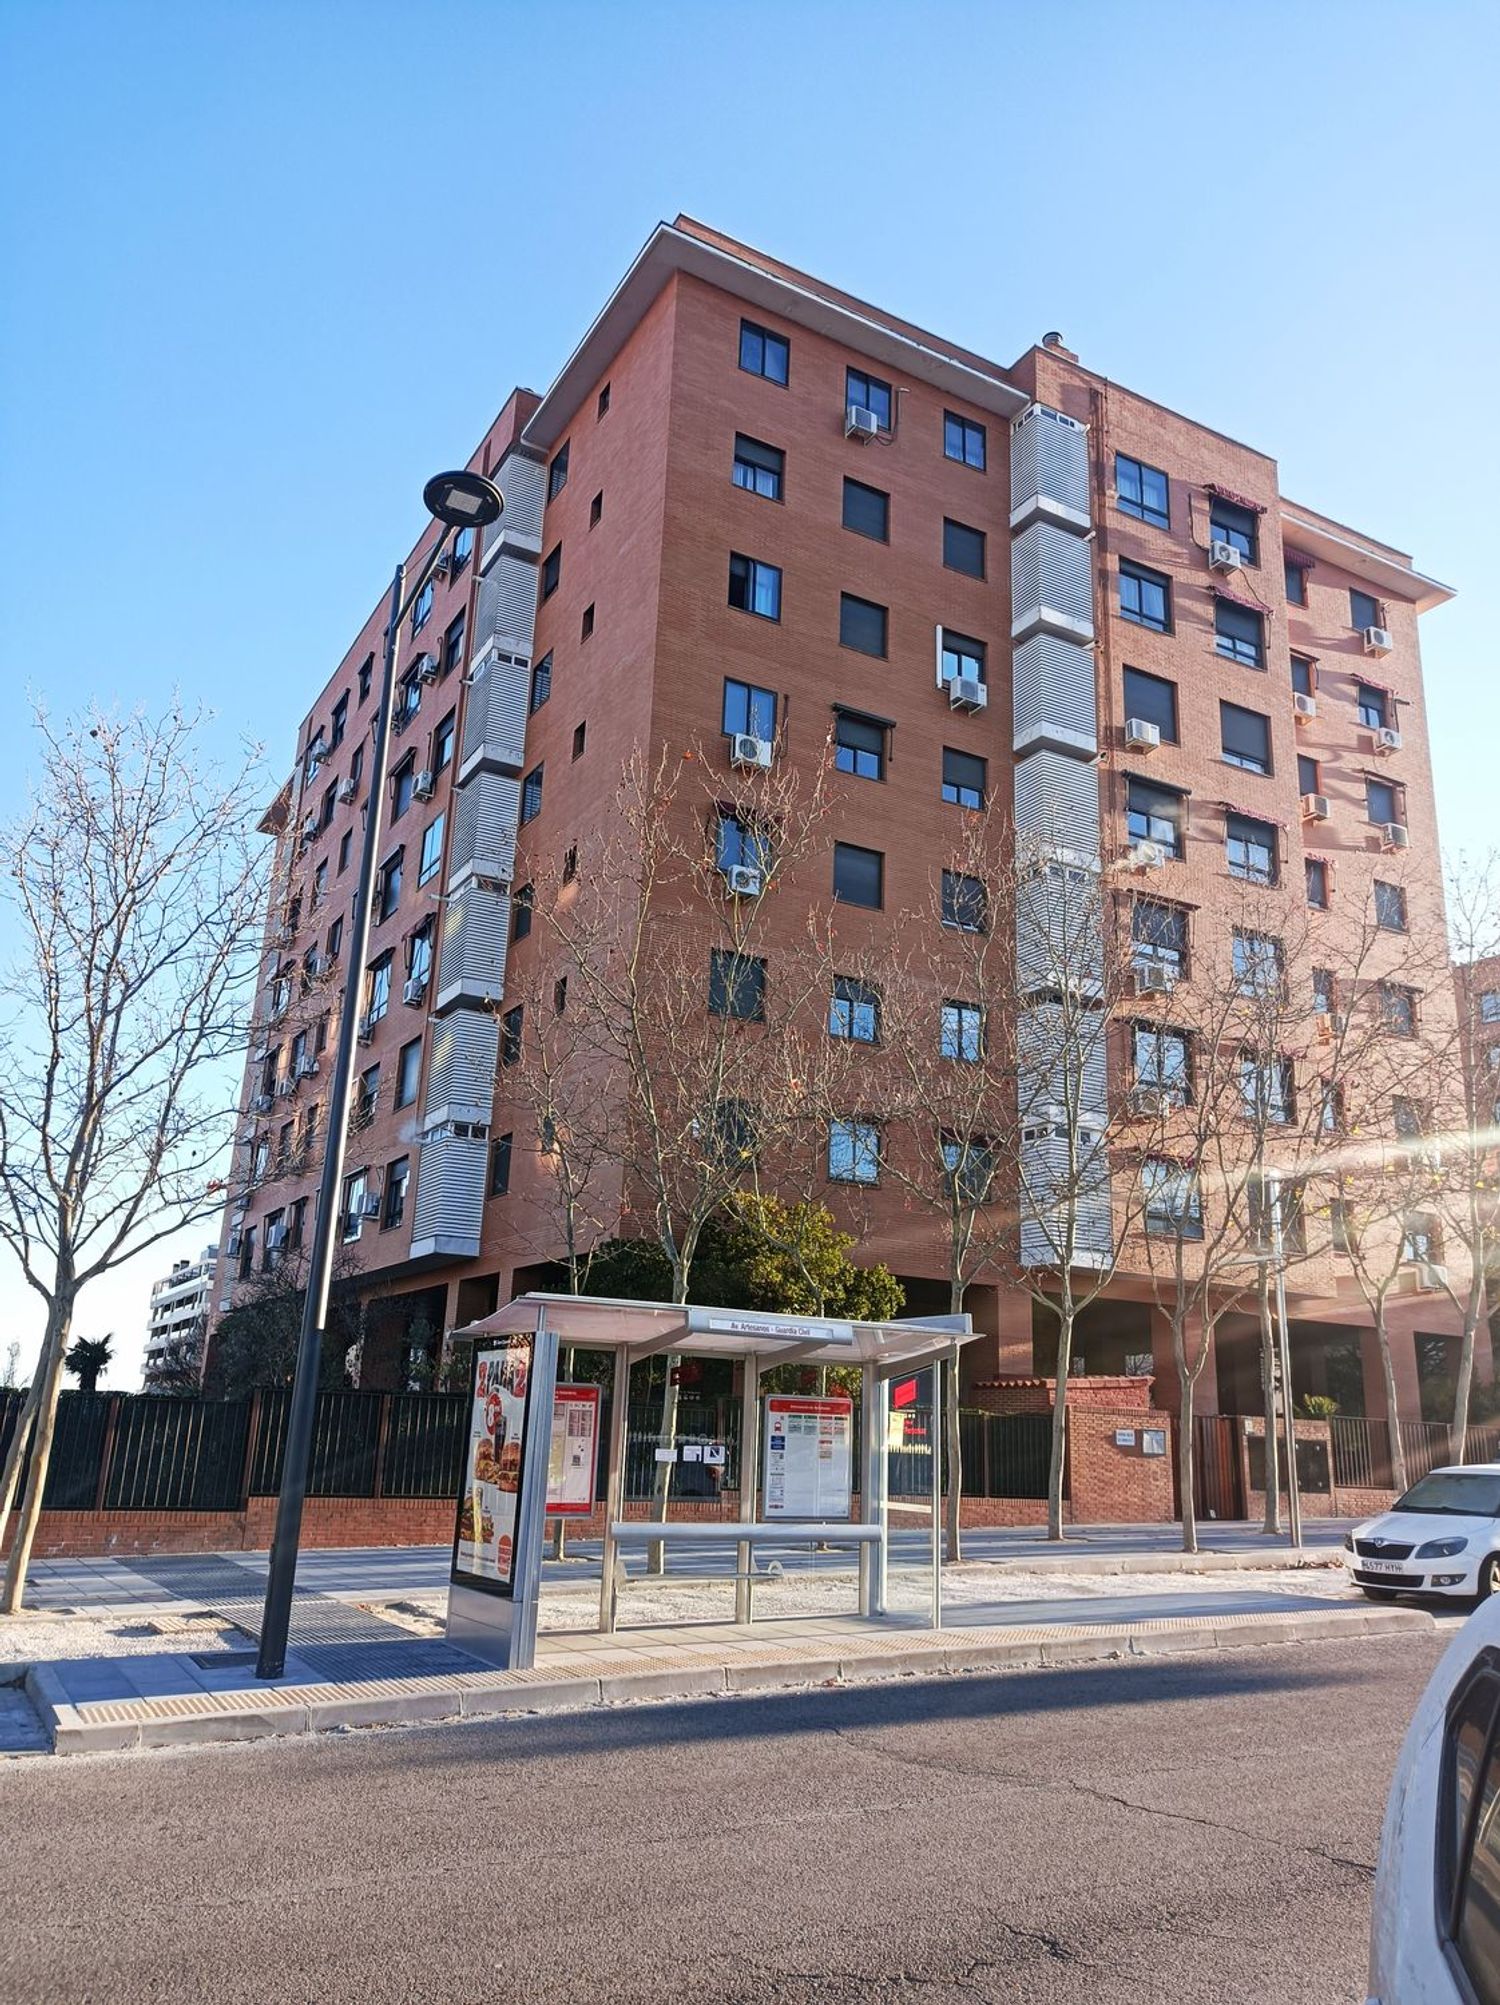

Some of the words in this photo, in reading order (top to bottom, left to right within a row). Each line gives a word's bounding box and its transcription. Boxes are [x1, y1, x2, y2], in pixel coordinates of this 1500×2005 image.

[741, 1322, 769, 1333] Artesanos
[775, 1326, 797, 1335] Guardia
[798, 1328, 810, 1336] Civil
[477, 1361, 488, 1398] 2
[512, 1360, 527, 1398] 2
